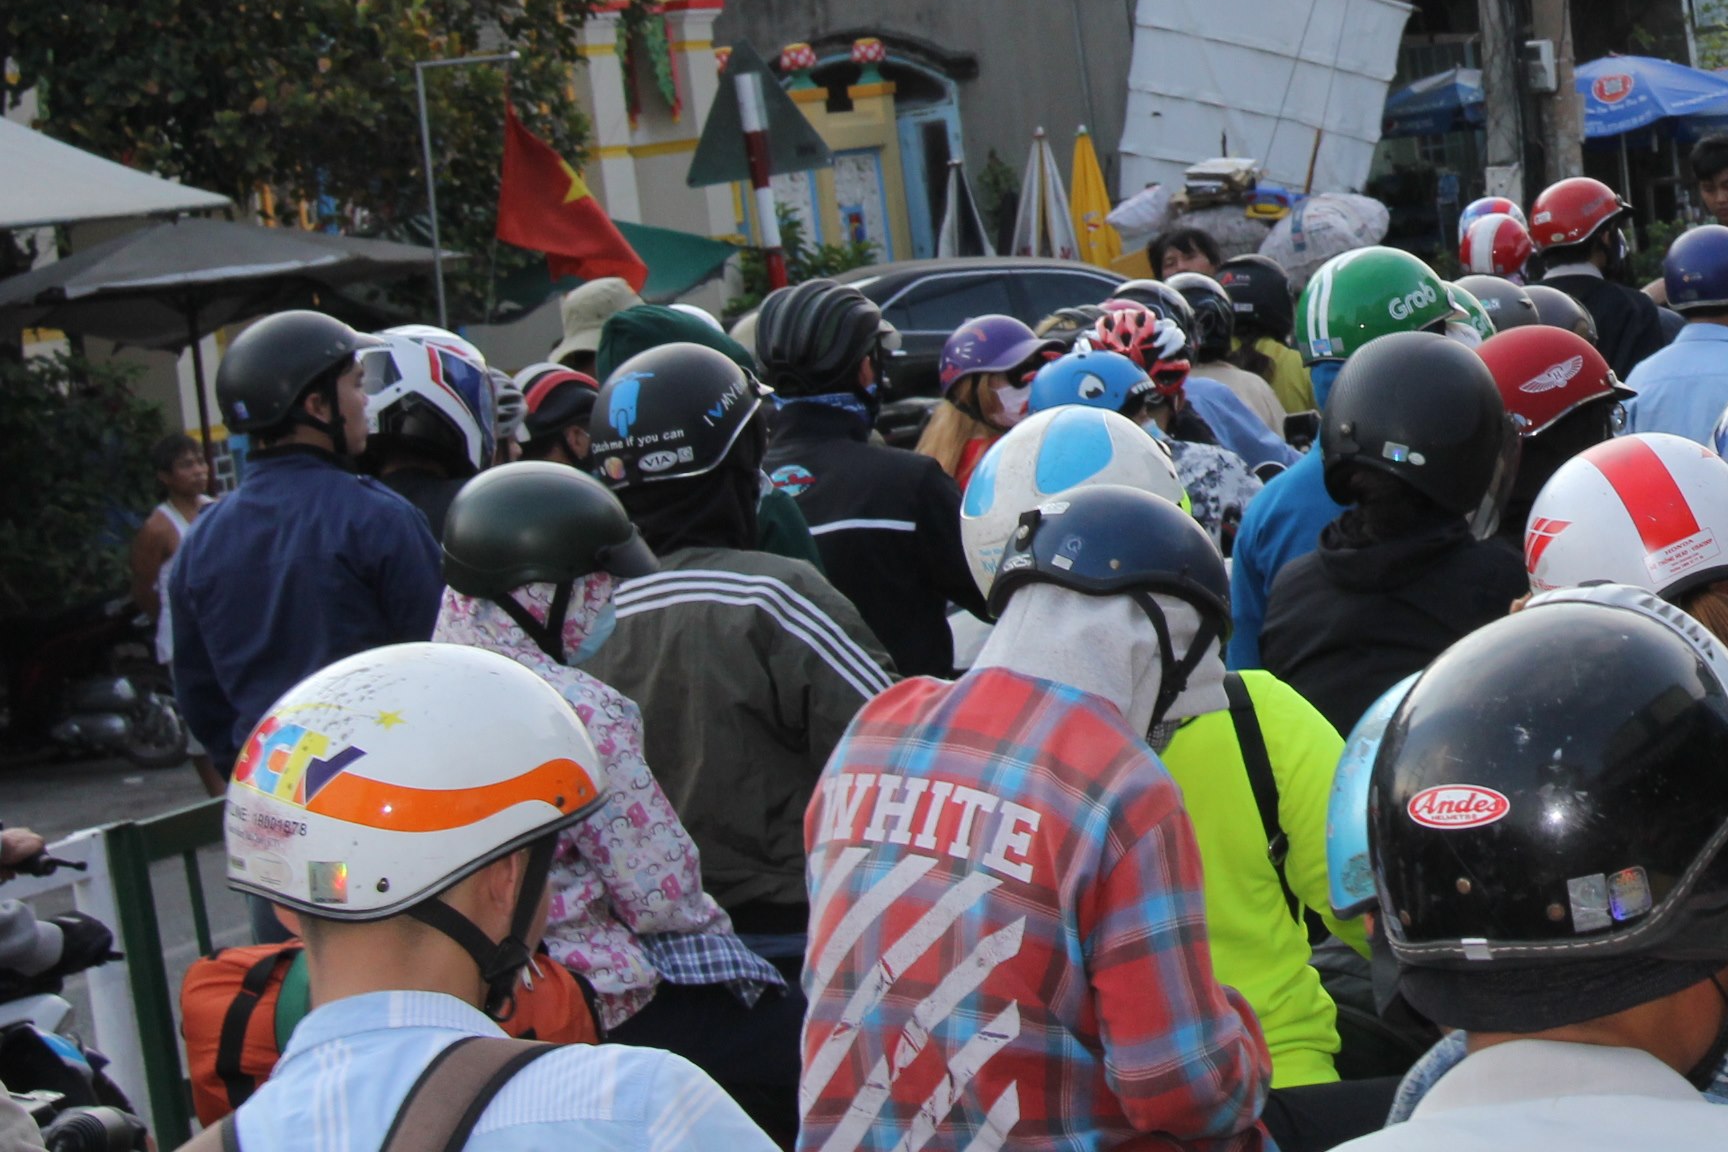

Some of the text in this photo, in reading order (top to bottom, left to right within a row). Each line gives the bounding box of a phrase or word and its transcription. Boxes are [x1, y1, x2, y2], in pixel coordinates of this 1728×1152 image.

[1389, 281, 1437, 320] Grab
[638, 433, 660, 448] you
[663, 428, 685, 441] can
[821, 773, 1041, 884] WHITE
